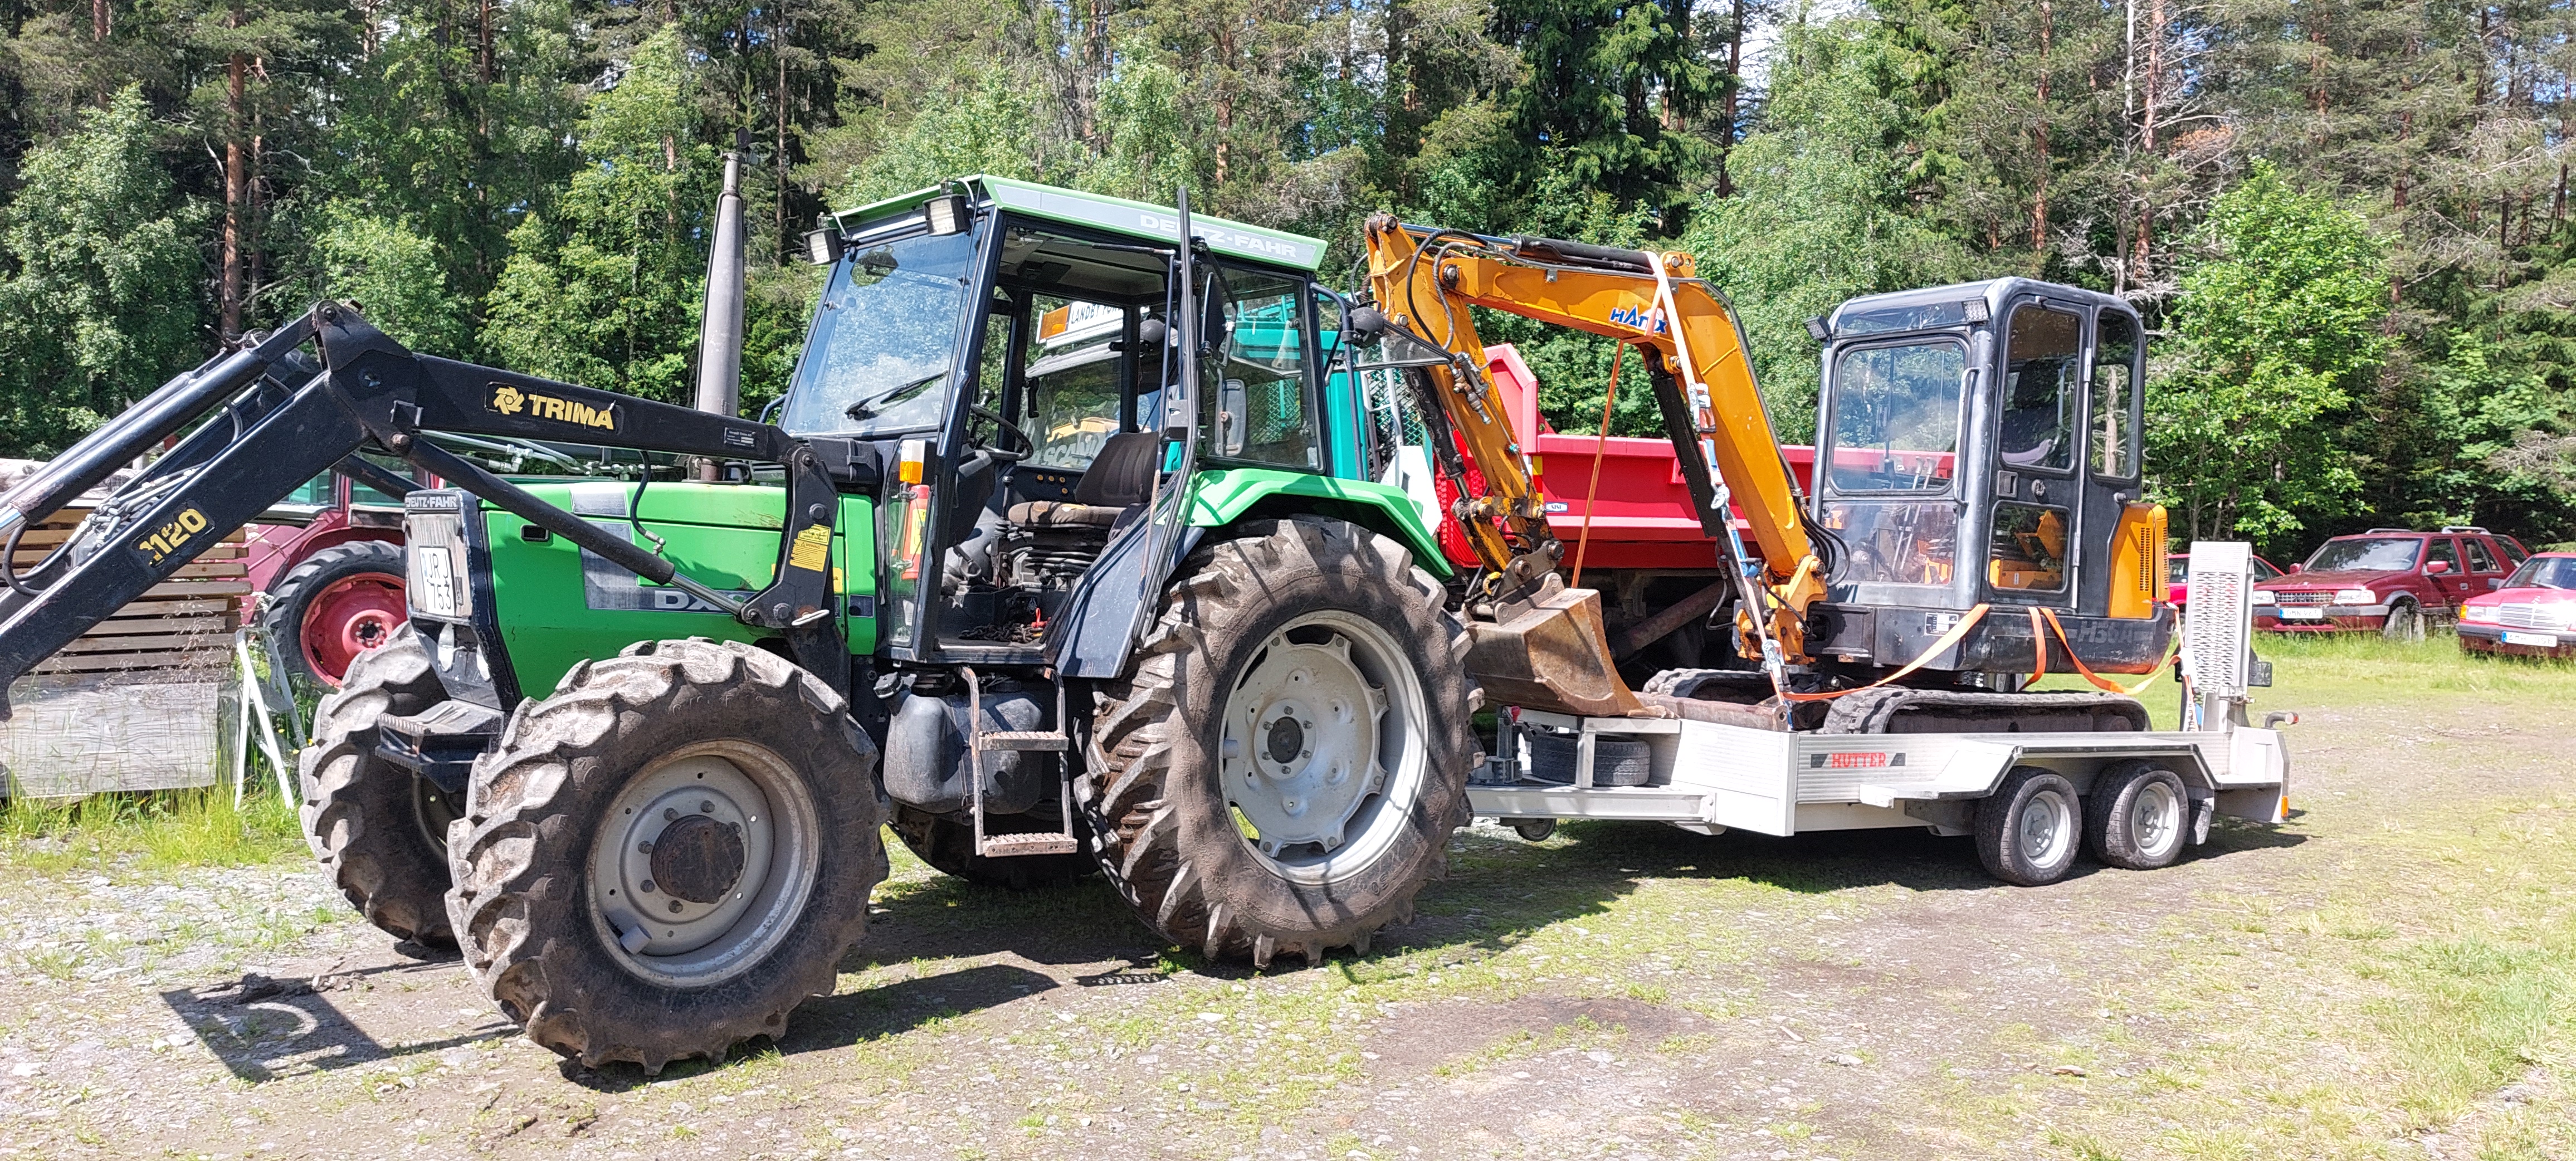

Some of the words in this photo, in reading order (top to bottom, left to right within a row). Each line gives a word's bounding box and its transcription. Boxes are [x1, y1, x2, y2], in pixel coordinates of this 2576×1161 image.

[1071, 304, 1101, 324] LANDBY
[1609, 306, 1667, 333] HANX
[529, 393, 614, 430] TRIMA
[655, 590, 745, 611] DX
[1831, 753, 1887, 768] HUTTER
